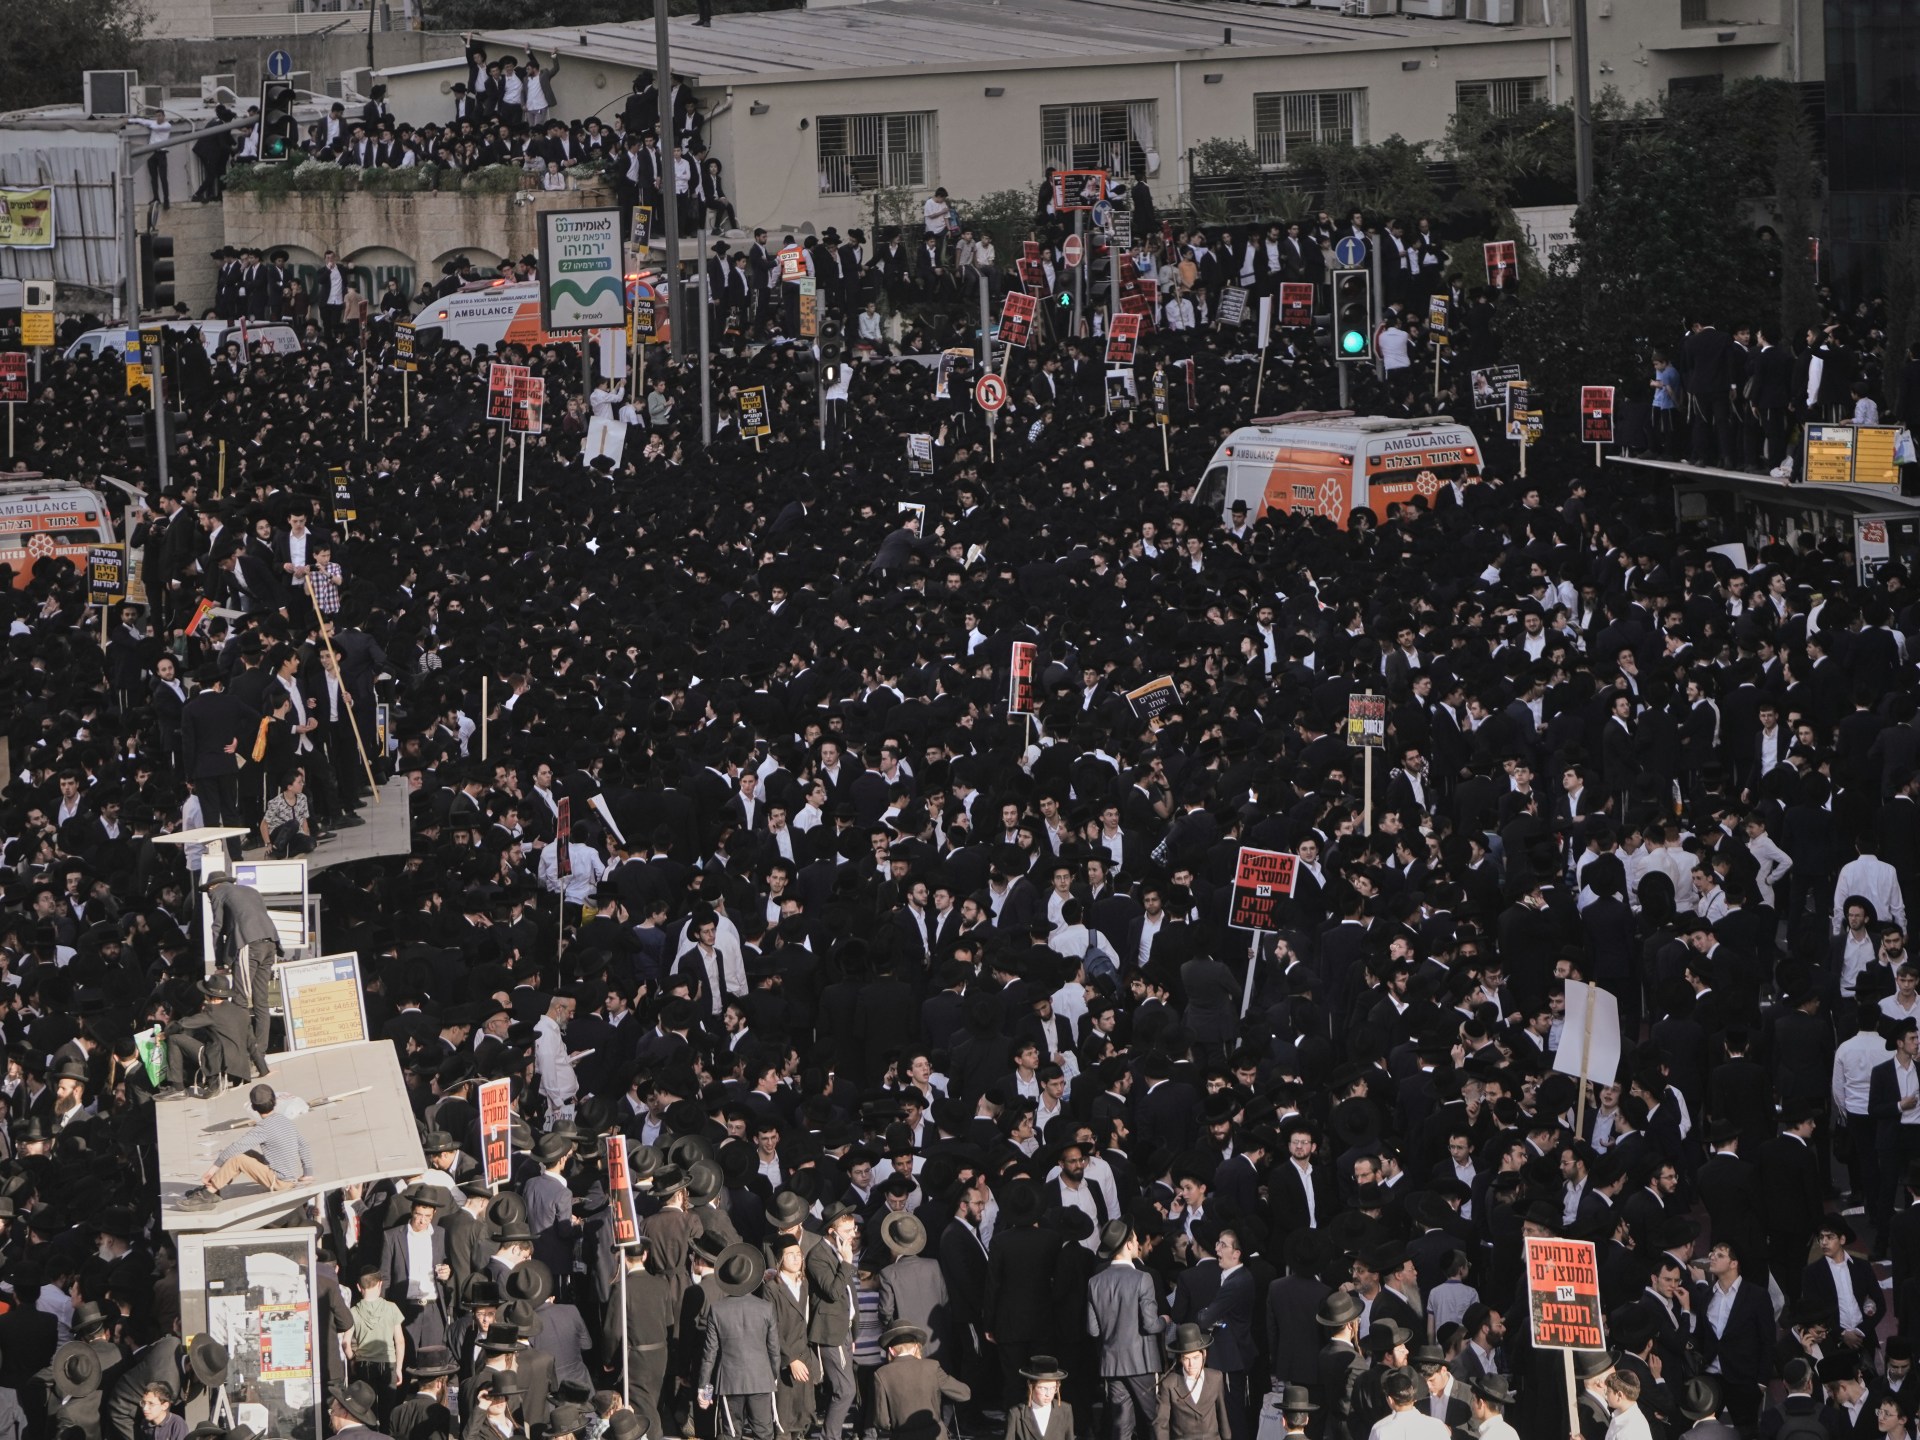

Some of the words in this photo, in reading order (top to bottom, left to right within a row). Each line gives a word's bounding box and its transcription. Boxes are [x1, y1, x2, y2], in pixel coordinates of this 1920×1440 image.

[557, 234, 580, 243] שיניים
[583, 233, 611, 241] מרפאת
[564, 243, 604, 256] ירמיהו
[454, 306, 514, 318] AMBULANCE
[1384, 435, 1461, 451] AMBULANCE
[1237, 450, 1274, 460] AMBULANCE
[1428, 451, 1461, 463] איחוד
[1386, 456, 1421, 468] הצלה
[1292, 485, 1315, 500] איחוד
[1383, 484, 1413, 493] UNITED
[0, 520, 31, 530] הצלה
[46, 516, 78, 527] איחוד
[56, 546, 88, 555] HATZAL
[95, 549, 117, 557] סגירת
[90, 556, 121, 565] הישיבות
[93, 580, 119, 588] ליהדות
[1139, 689, 1170, 704] מחזירים
[1149, 697, 1167, 708] אותו
[1242, 853, 1277, 869] נרתעים
[1280, 858, 1293, 871] לא
[1239, 867, 1290, 885] ממעצרים.
[1258, 886, 1270, 894] אך
[499, 1086, 508, 1102] לא
[1531, 1245, 1574, 1263] נרתעים
[1578, 1247, 1592, 1264] לא
[1533, 1264, 1594, 1284] ממעצרים.
[1558, 1288, 1572, 1299] אך
[1542, 1302, 1590, 1324] רועדים
[1536, 1322, 1601, 1344] מהיעדים.
